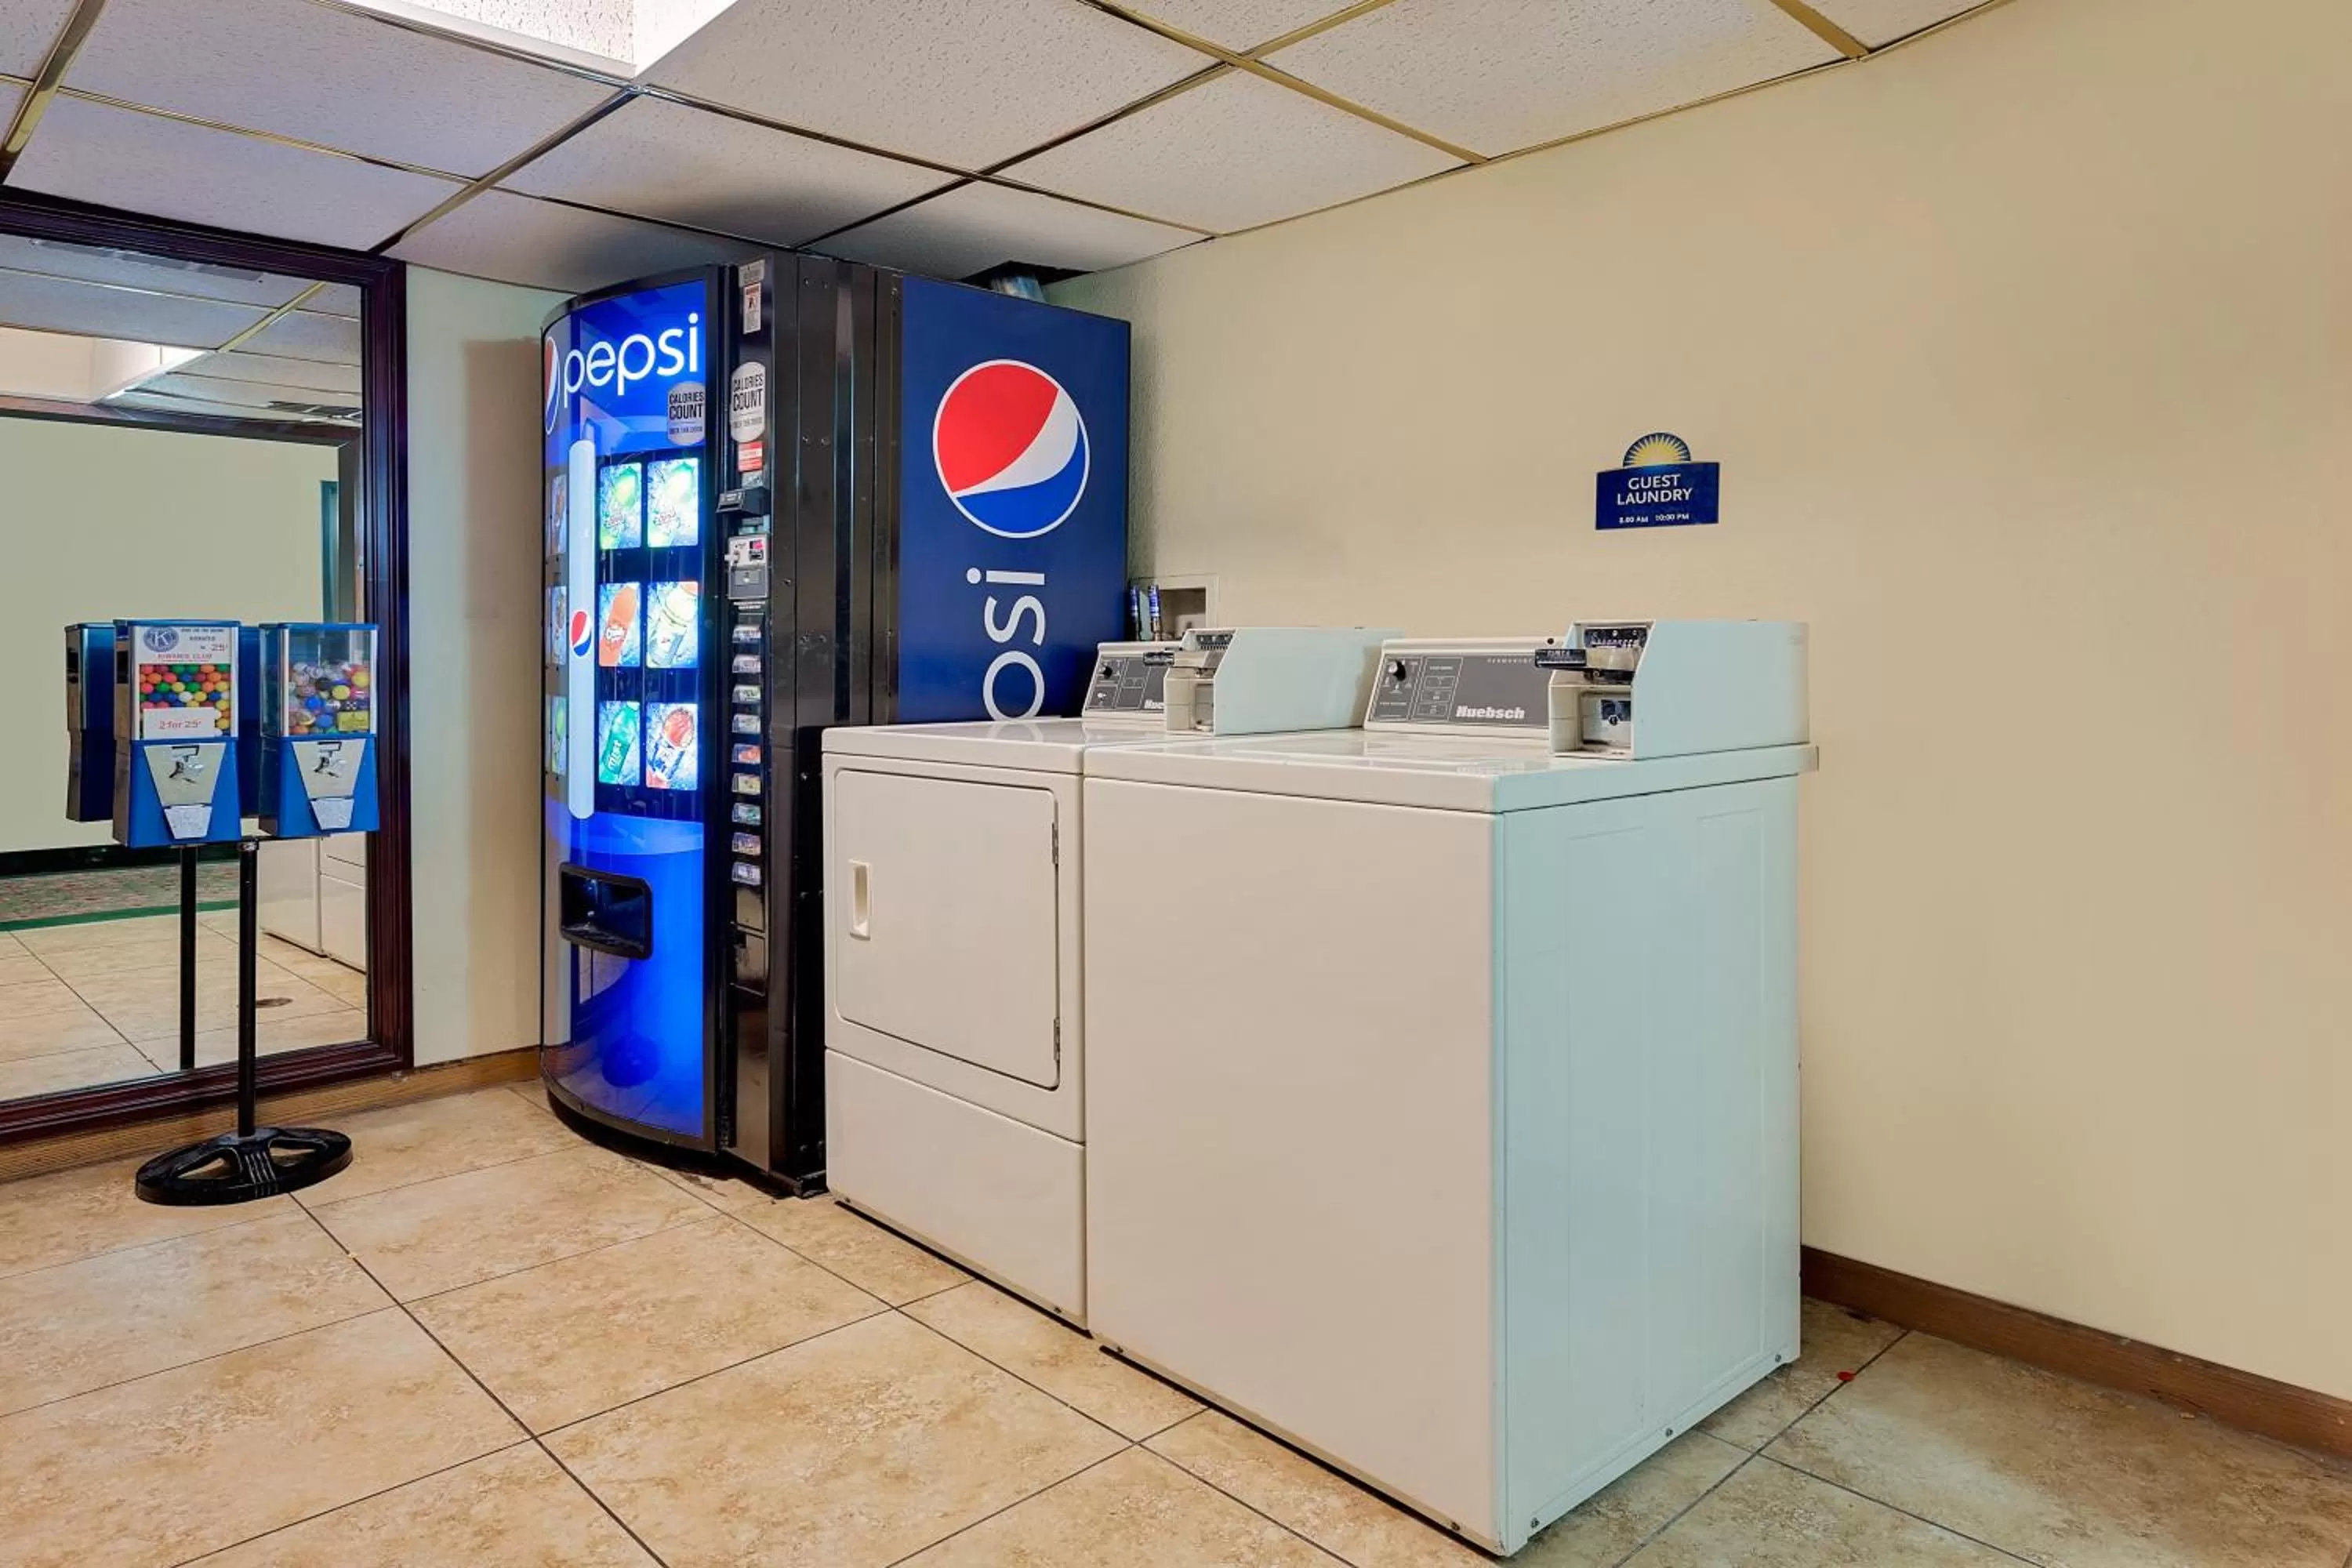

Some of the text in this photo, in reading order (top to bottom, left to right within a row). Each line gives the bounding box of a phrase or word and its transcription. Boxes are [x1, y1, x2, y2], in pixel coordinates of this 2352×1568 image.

[564, 313, 699, 408] pepsi
[733, 373, 764, 393] CALORIES
[669, 391, 703, 405] CALORIES
[732, 388, 764, 412] COUNT
[669, 403, 703, 420] COUNT
[1628, 474, 1682, 490] GUEST
[1617, 487, 1693, 506] LAUNDRY
[1456, 705, 1526, 720] Huebsch
[166, 720, 183, 728] for
